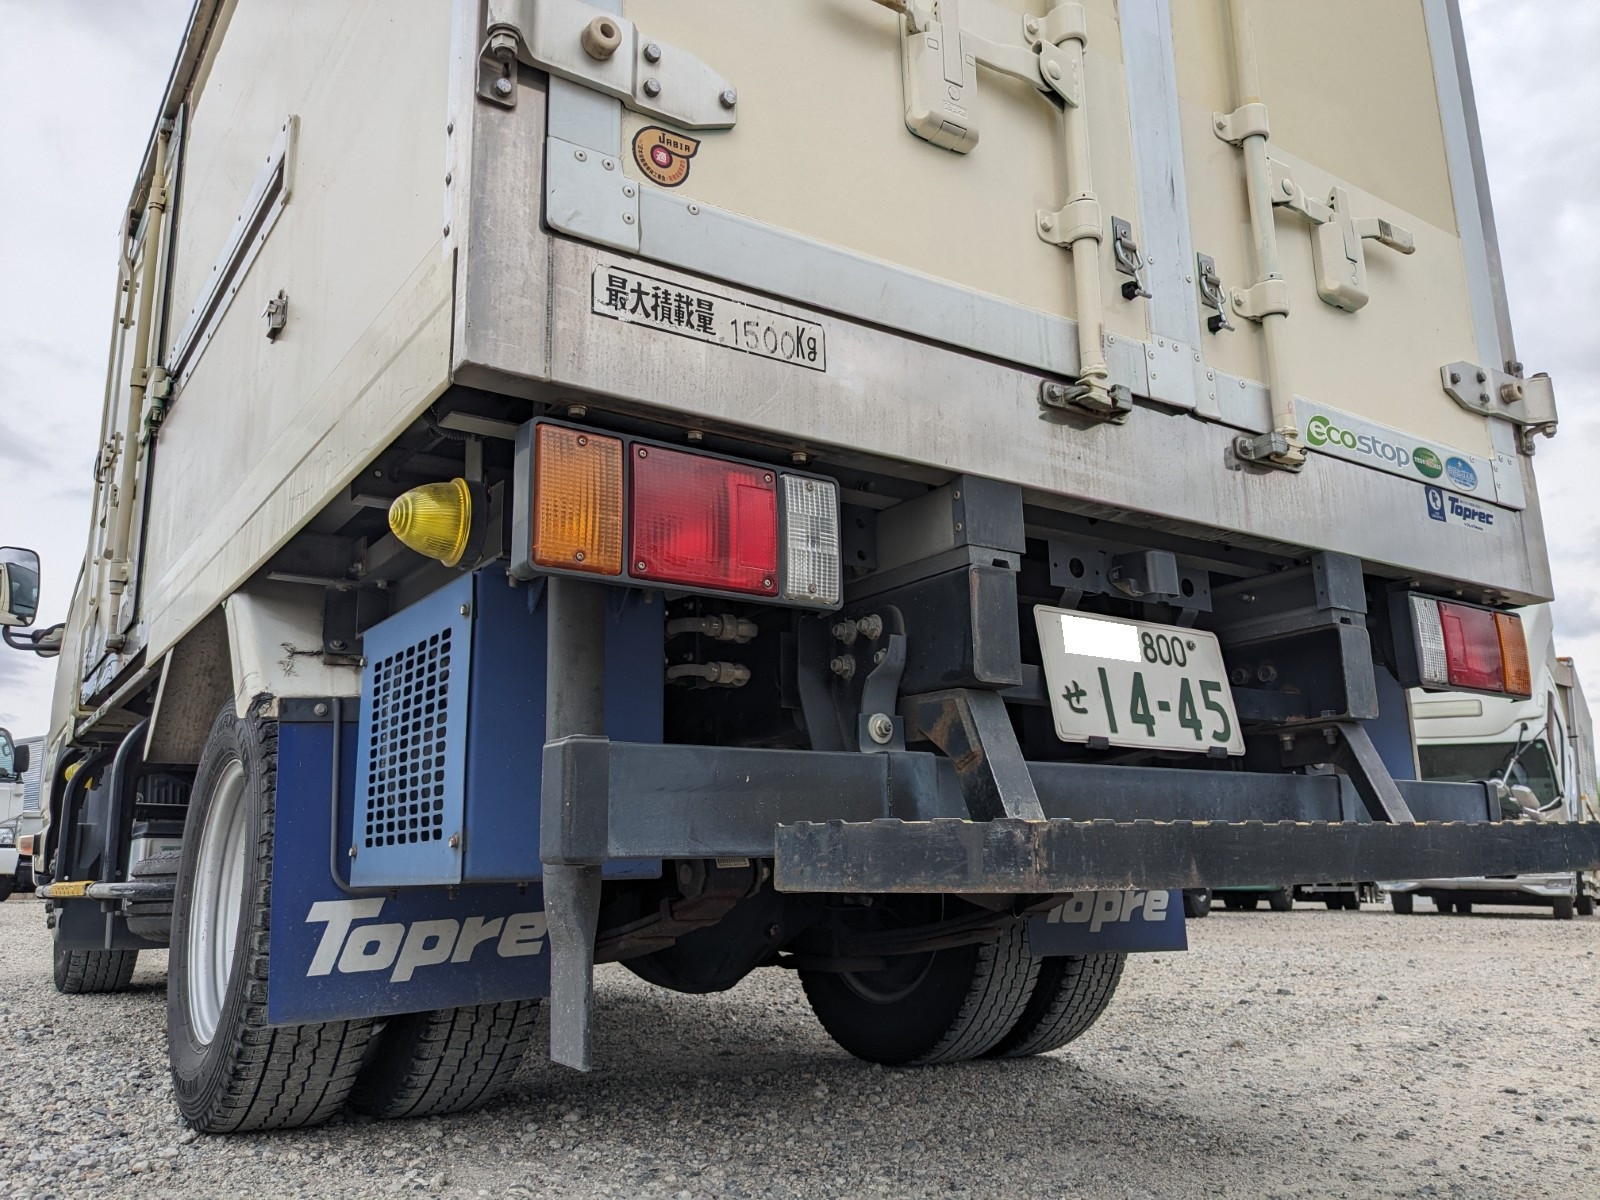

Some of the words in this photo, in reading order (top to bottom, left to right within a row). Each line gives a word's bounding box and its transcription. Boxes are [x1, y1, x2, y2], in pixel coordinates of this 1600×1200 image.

[658, 132, 691, 153] JABIA
[606, 273, 717, 336] 最大積載量
[1306, 414, 1410, 468] ecostop
[1448, 496, 1494, 526] Toprec
[1141, 632, 1187, 667] 800
[1062, 680, 1088, 714] せ
[1097, 666, 1232, 743] 14-45
[305, 897, 548, 983] Topre
